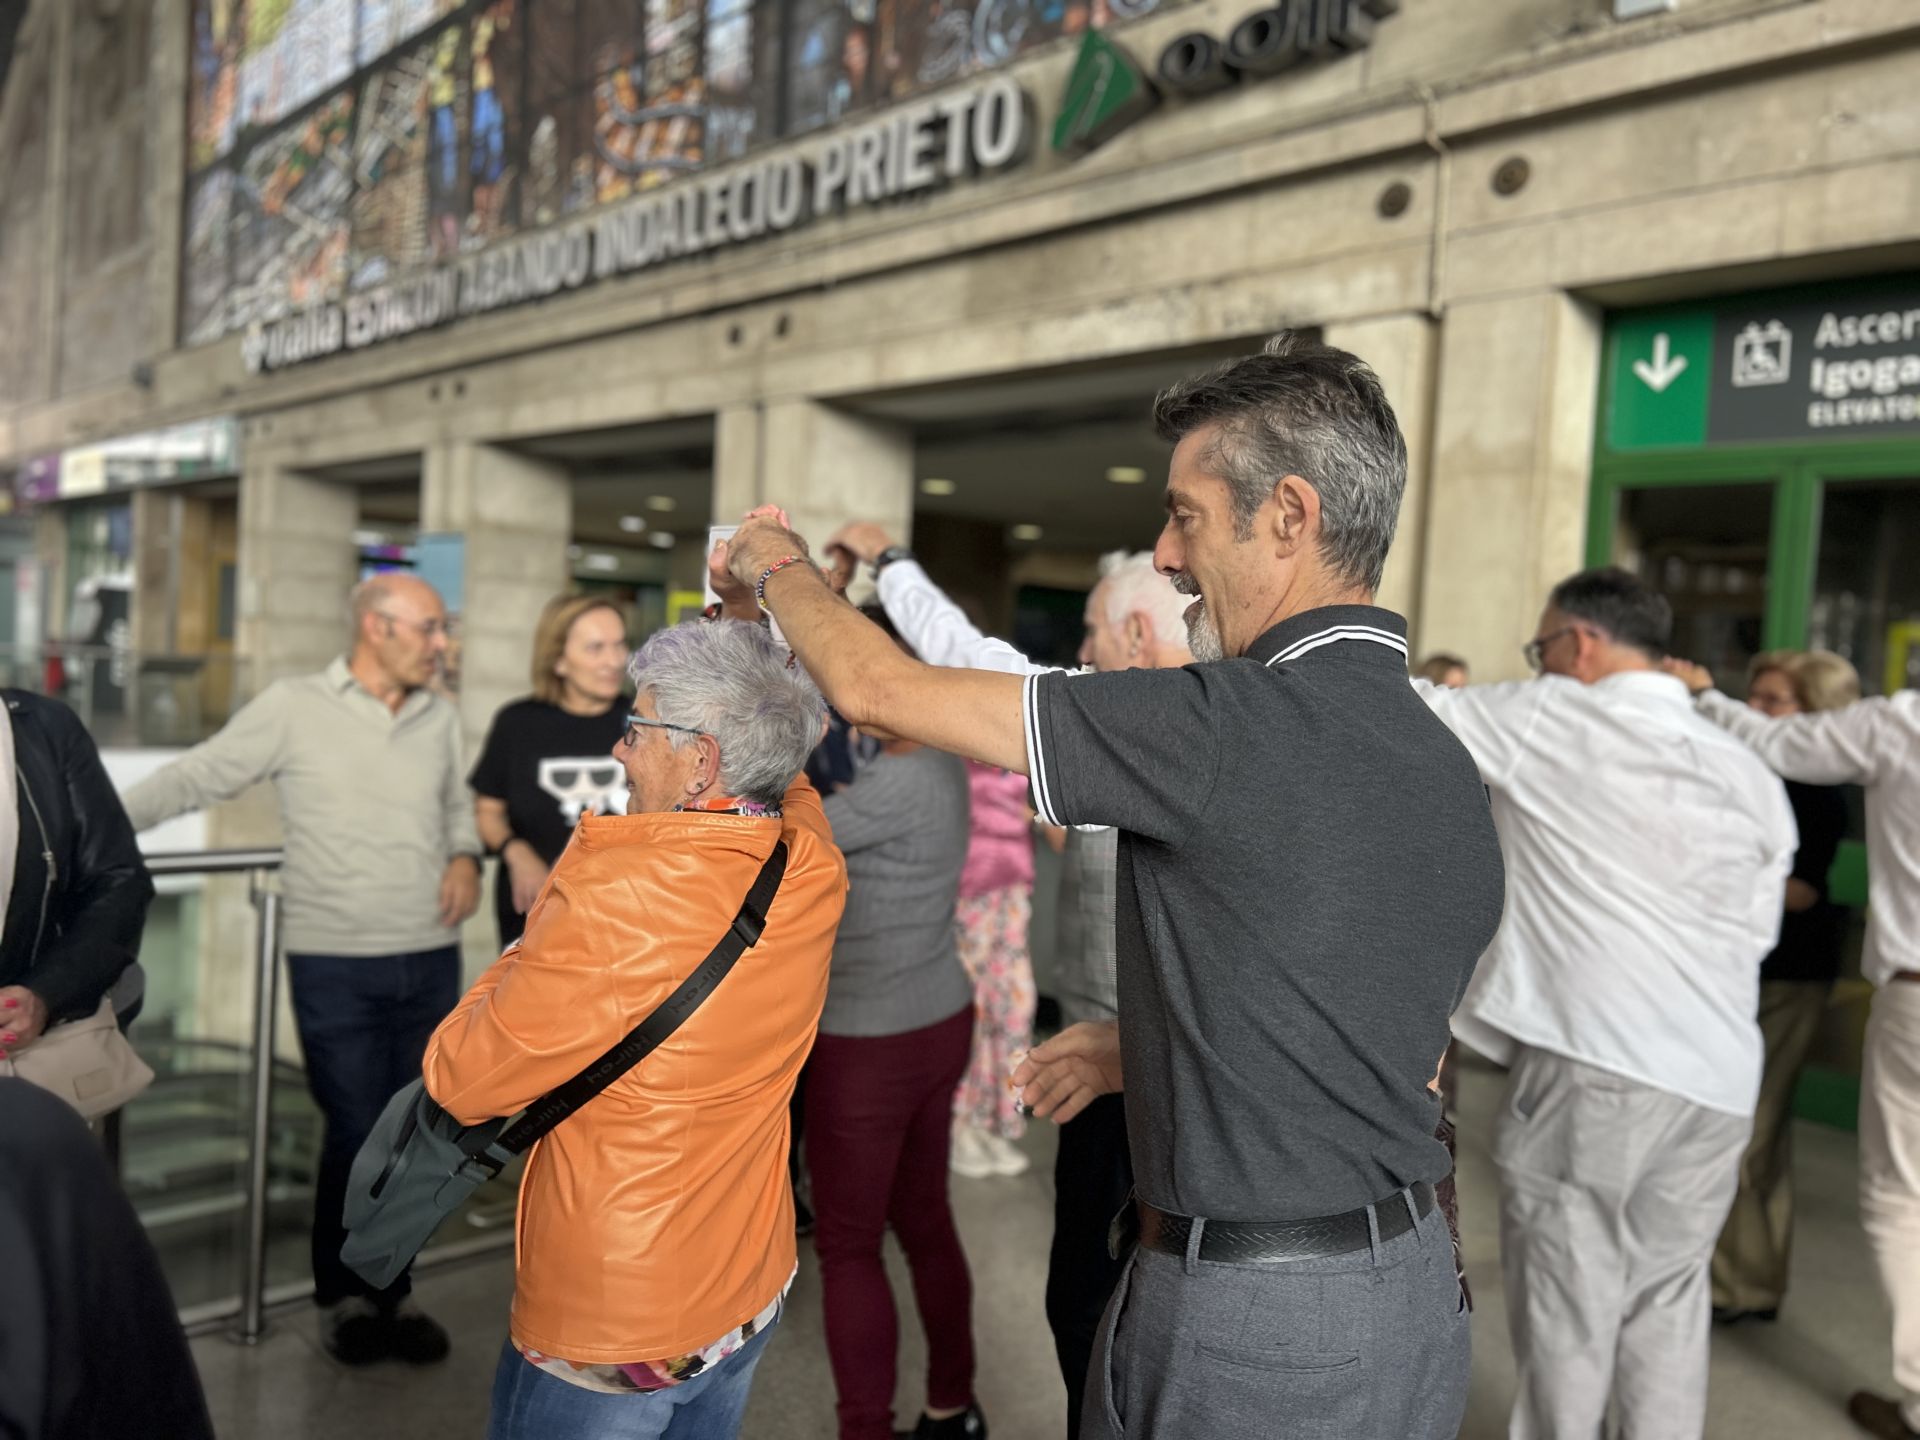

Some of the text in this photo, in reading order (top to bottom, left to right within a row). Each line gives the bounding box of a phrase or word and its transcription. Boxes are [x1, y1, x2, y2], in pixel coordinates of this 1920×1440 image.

[459, 221, 588, 312] ABANDO
[593, 157, 801, 277] INDALECIO
[812, 76, 1023, 216] PRIETO
